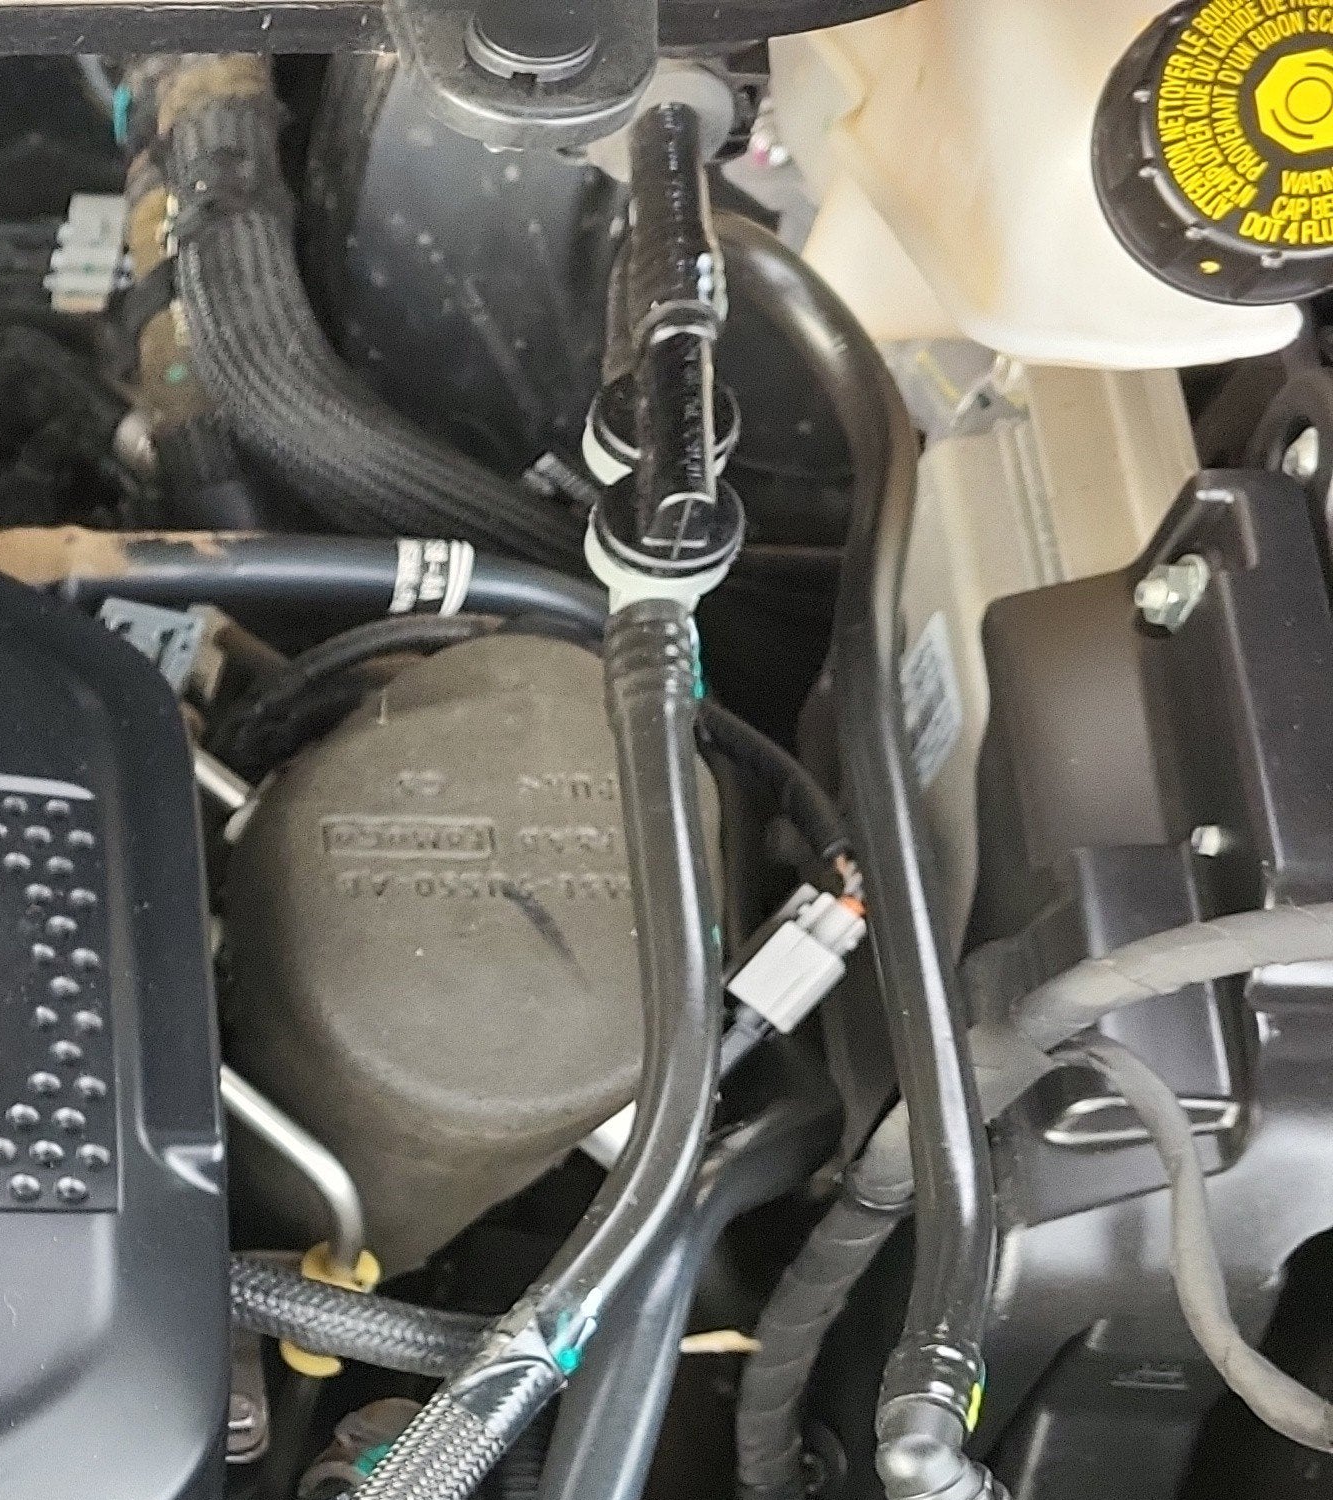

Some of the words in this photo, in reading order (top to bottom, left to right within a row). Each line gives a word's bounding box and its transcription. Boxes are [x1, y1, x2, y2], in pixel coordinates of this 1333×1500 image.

[1176, 29, 1208, 55] LE
[1202, 1, 1264, 58] LIQUIDE
[1247, 10, 1305, 50] BIDON
[1189, 55, 1221, 81] DU
[1217, 41, 1259, 85] D'UN
[1158, 54, 1194, 142] NETTOYER
[1183, 83, 1213, 117] QUE
[1212, 85, 1269, 181] PROVENANT
[1163, 140, 1234, 219] ATTENTION
[1185, 118, 1258, 208] N'EMPLOYER
[1239, 211, 1286, 243] DOT
[1282, 221, 1299, 245] 4
[1271, 195, 1311, 221] CAP
